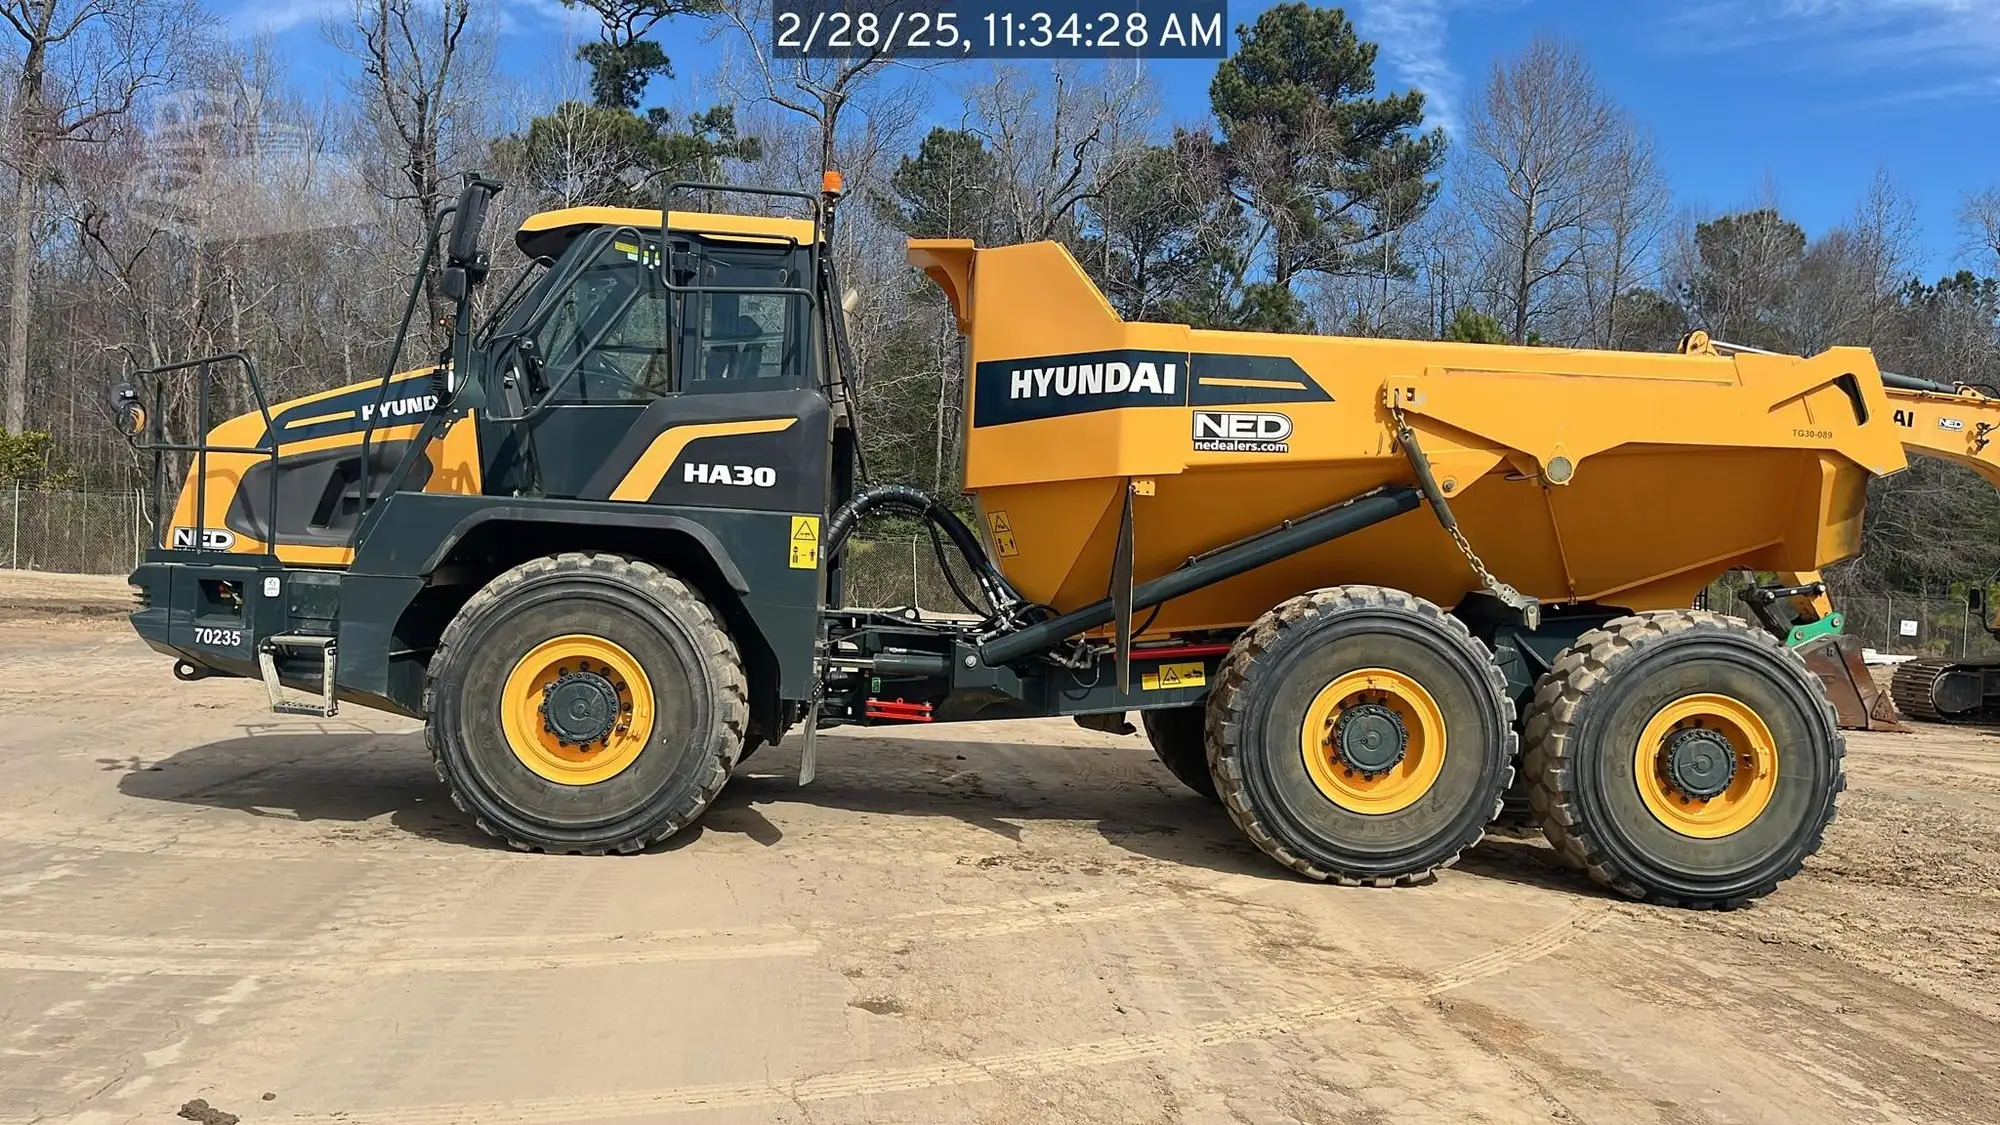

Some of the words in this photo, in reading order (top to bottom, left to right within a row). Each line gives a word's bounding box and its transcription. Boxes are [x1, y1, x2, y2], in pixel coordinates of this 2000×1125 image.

[1010, 361, 1177, 400] HYUNDAI
[361, 394, 439, 421] HYUND
[1194, 414, 1291, 440] NED
[1791, 428, 1833, 440] TG30-089
[1194, 440, 1289, 453] nedealers.com
[683, 462, 777, 487] HA30
[174, 528, 234, 549] NED
[194, 628, 241, 647] 70235
